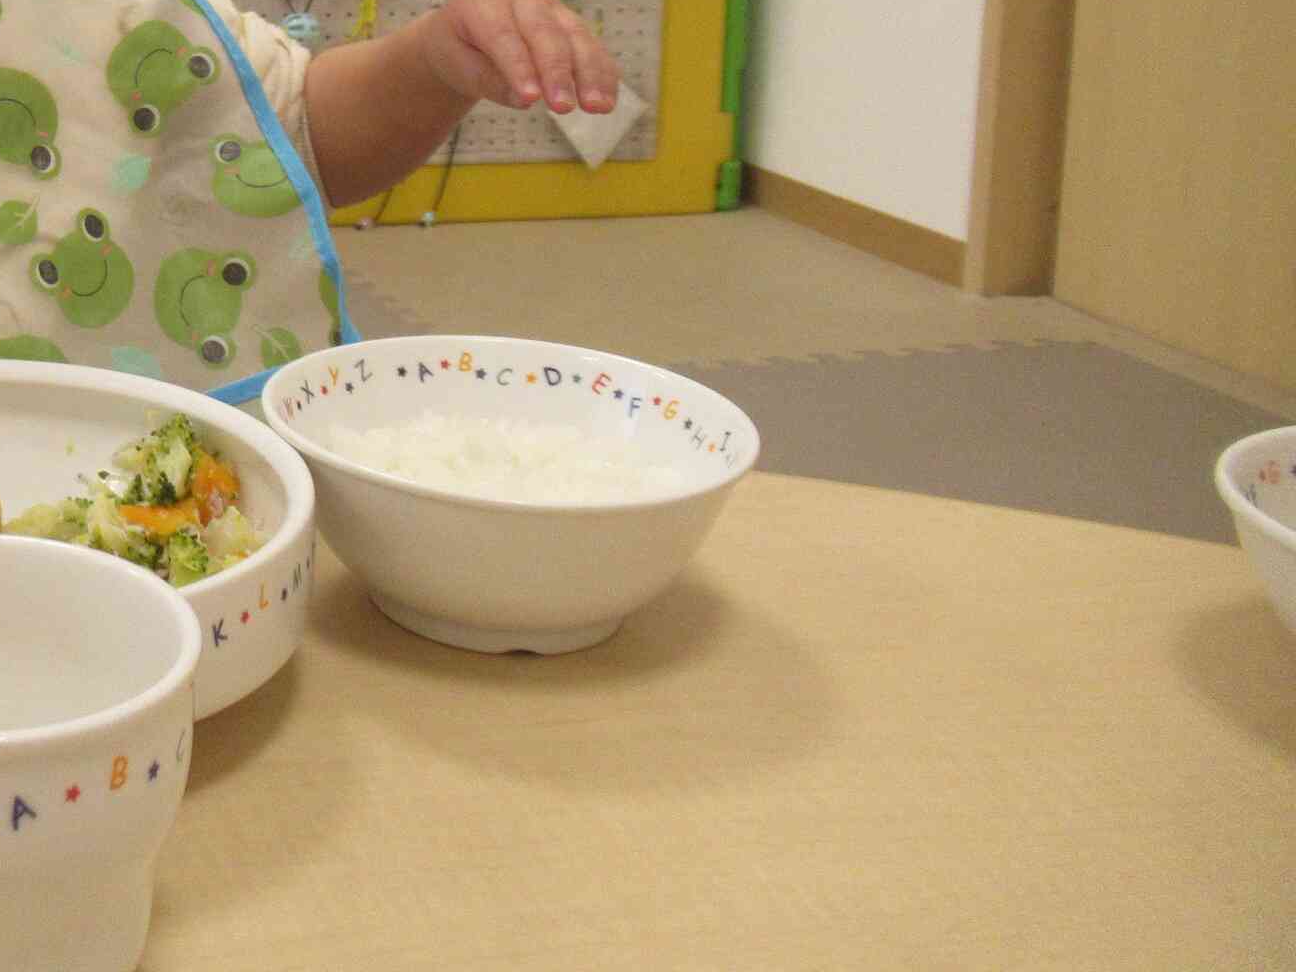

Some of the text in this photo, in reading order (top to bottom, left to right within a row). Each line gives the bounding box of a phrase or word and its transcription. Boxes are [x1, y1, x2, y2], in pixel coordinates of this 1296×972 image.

[301, 379, 315, 404] X
[328, 365, 339, 386] Y
[354, 359, 373, 382] Z
[418, 361, 434, 383] A
[459, 351, 472, 373] B
[496, 368, 513, 386] C
[543, 367, 562, 386] D
[592, 372, 612, 395] E
[628, 397, 642, 418] F
[663, 400, 680, 421] G
[212, 618, 228, 647] K
[259, 582, 270, 611] L
[11, 793, 38, 831] A
[110, 756, 128, 792] B
